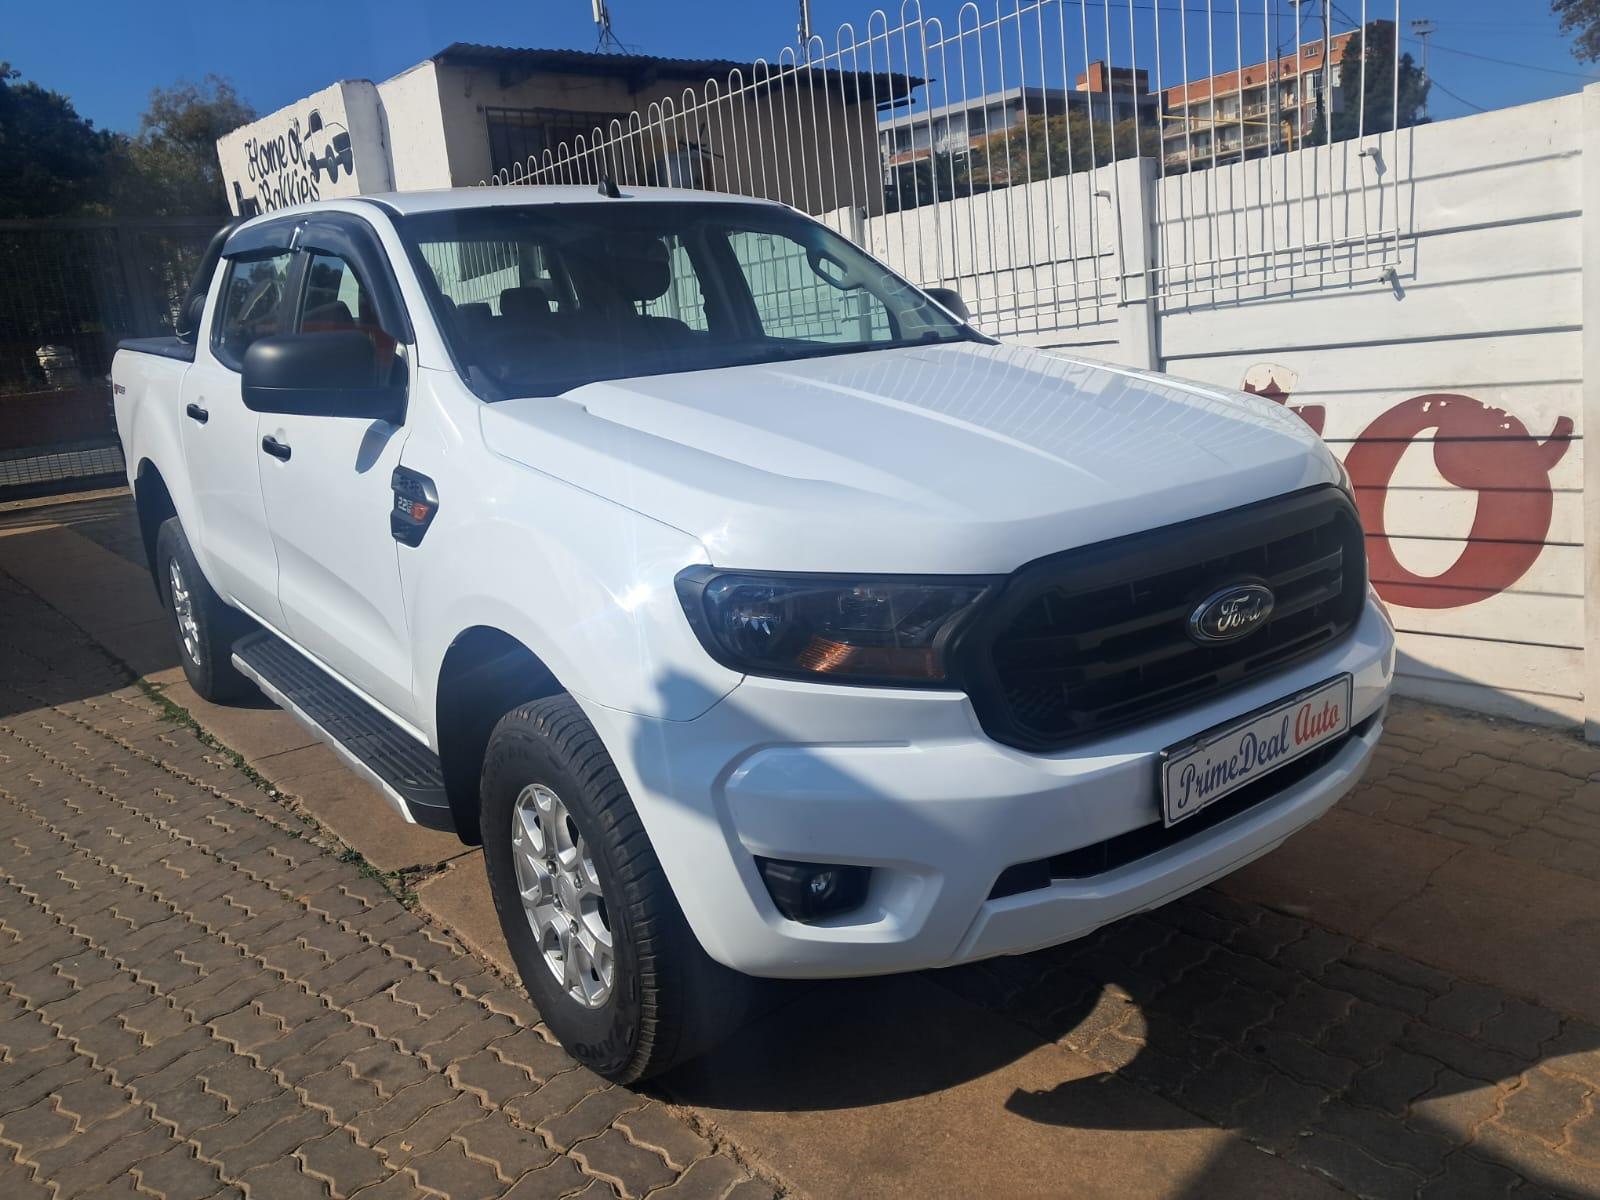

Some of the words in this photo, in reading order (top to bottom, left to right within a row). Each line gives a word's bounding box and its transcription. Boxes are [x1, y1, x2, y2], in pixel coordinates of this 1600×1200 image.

[244, 134, 288, 182] Home
[1217, 593, 1262, 633] Ford
[1177, 714, 1290, 809] PrimeDeal
[1294, 701, 1341, 746] Auto
